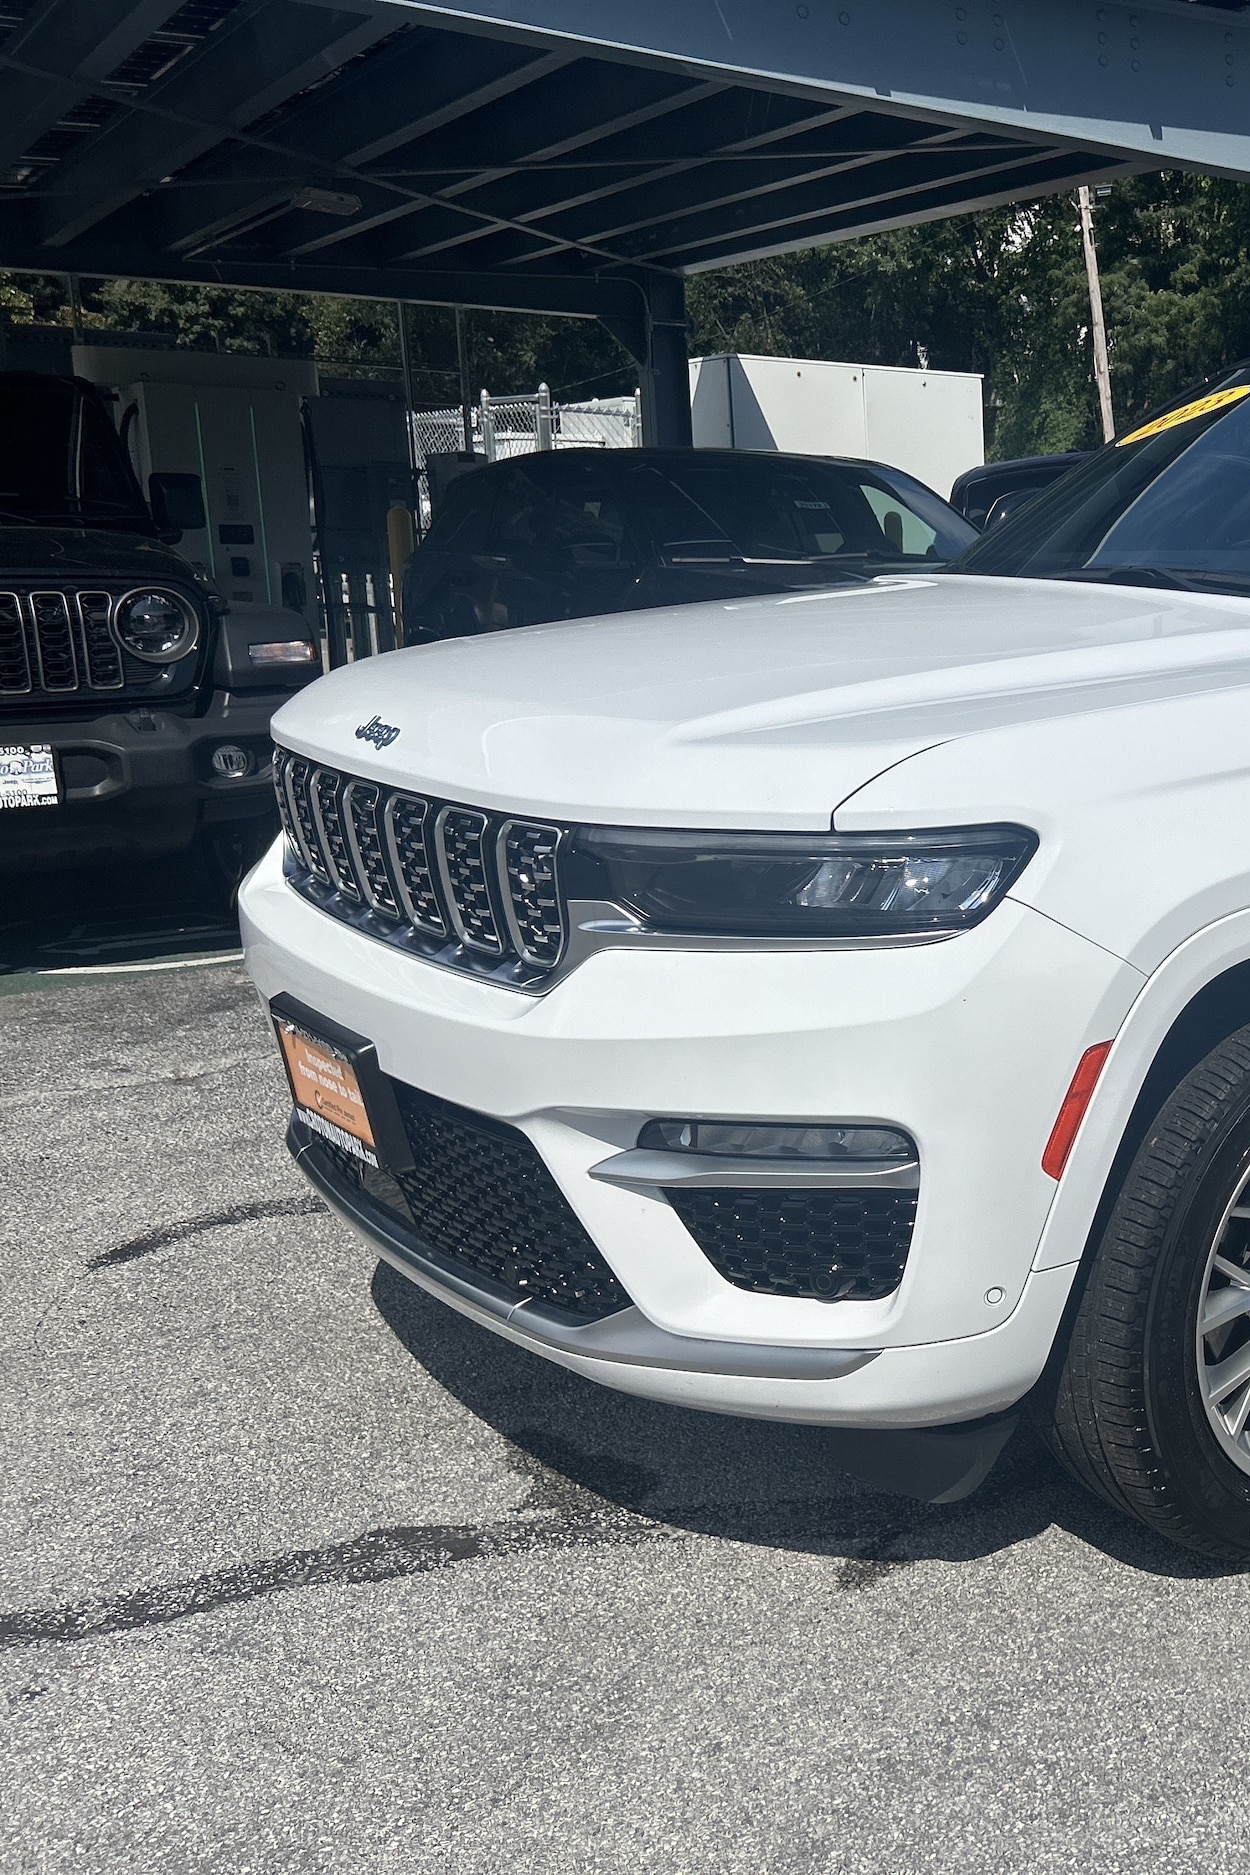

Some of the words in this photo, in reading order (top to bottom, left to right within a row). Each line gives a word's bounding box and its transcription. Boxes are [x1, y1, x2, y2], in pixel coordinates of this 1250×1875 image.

[355, 715, 401, 750] Jeep
[23, 757, 54, 773] Park
[298, 1060, 319, 1083] from
[318, 1074, 338, 1093] nose
[338, 1082, 348, 1098] to
[305, 1048, 344, 1080] Inspected
